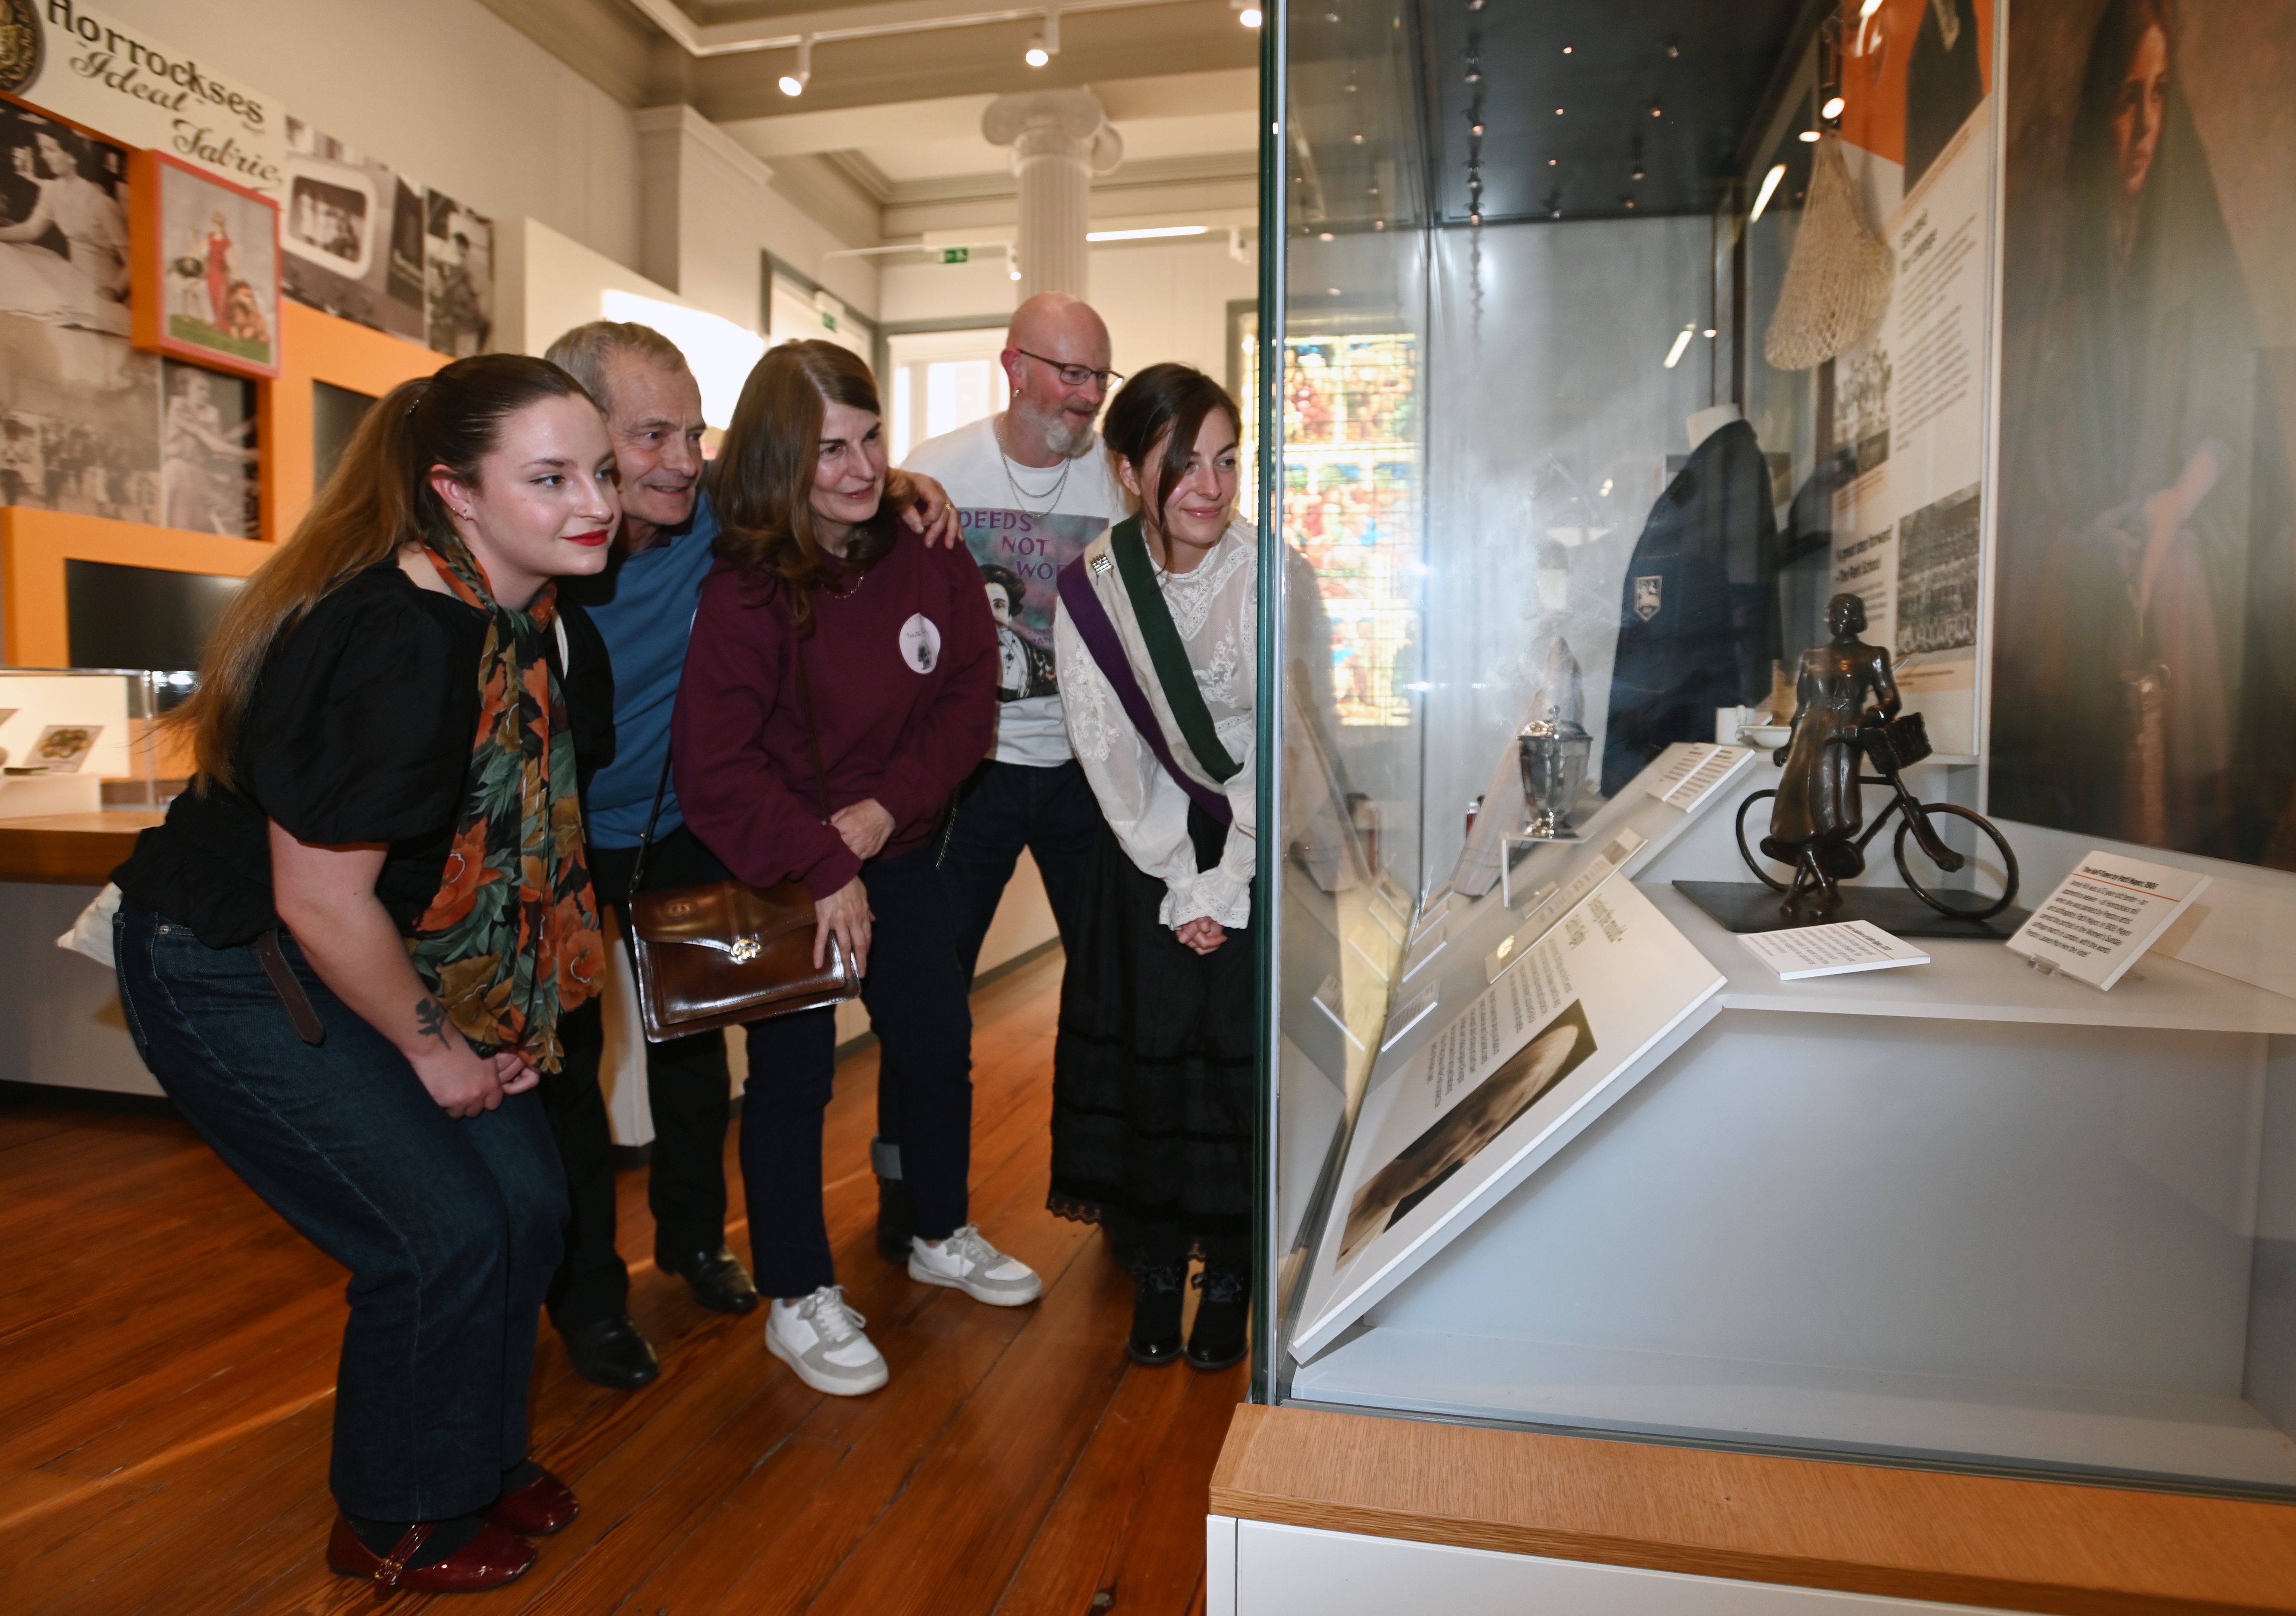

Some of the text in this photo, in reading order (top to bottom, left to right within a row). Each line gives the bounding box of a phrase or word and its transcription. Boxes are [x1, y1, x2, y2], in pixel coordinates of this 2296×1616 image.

[47, 0, 264, 124] Horrockses
[69, 51, 187, 112] Ideal
[959, 511, 1032, 532] DEEDS
[1001, 535, 1050, 556] NOT
